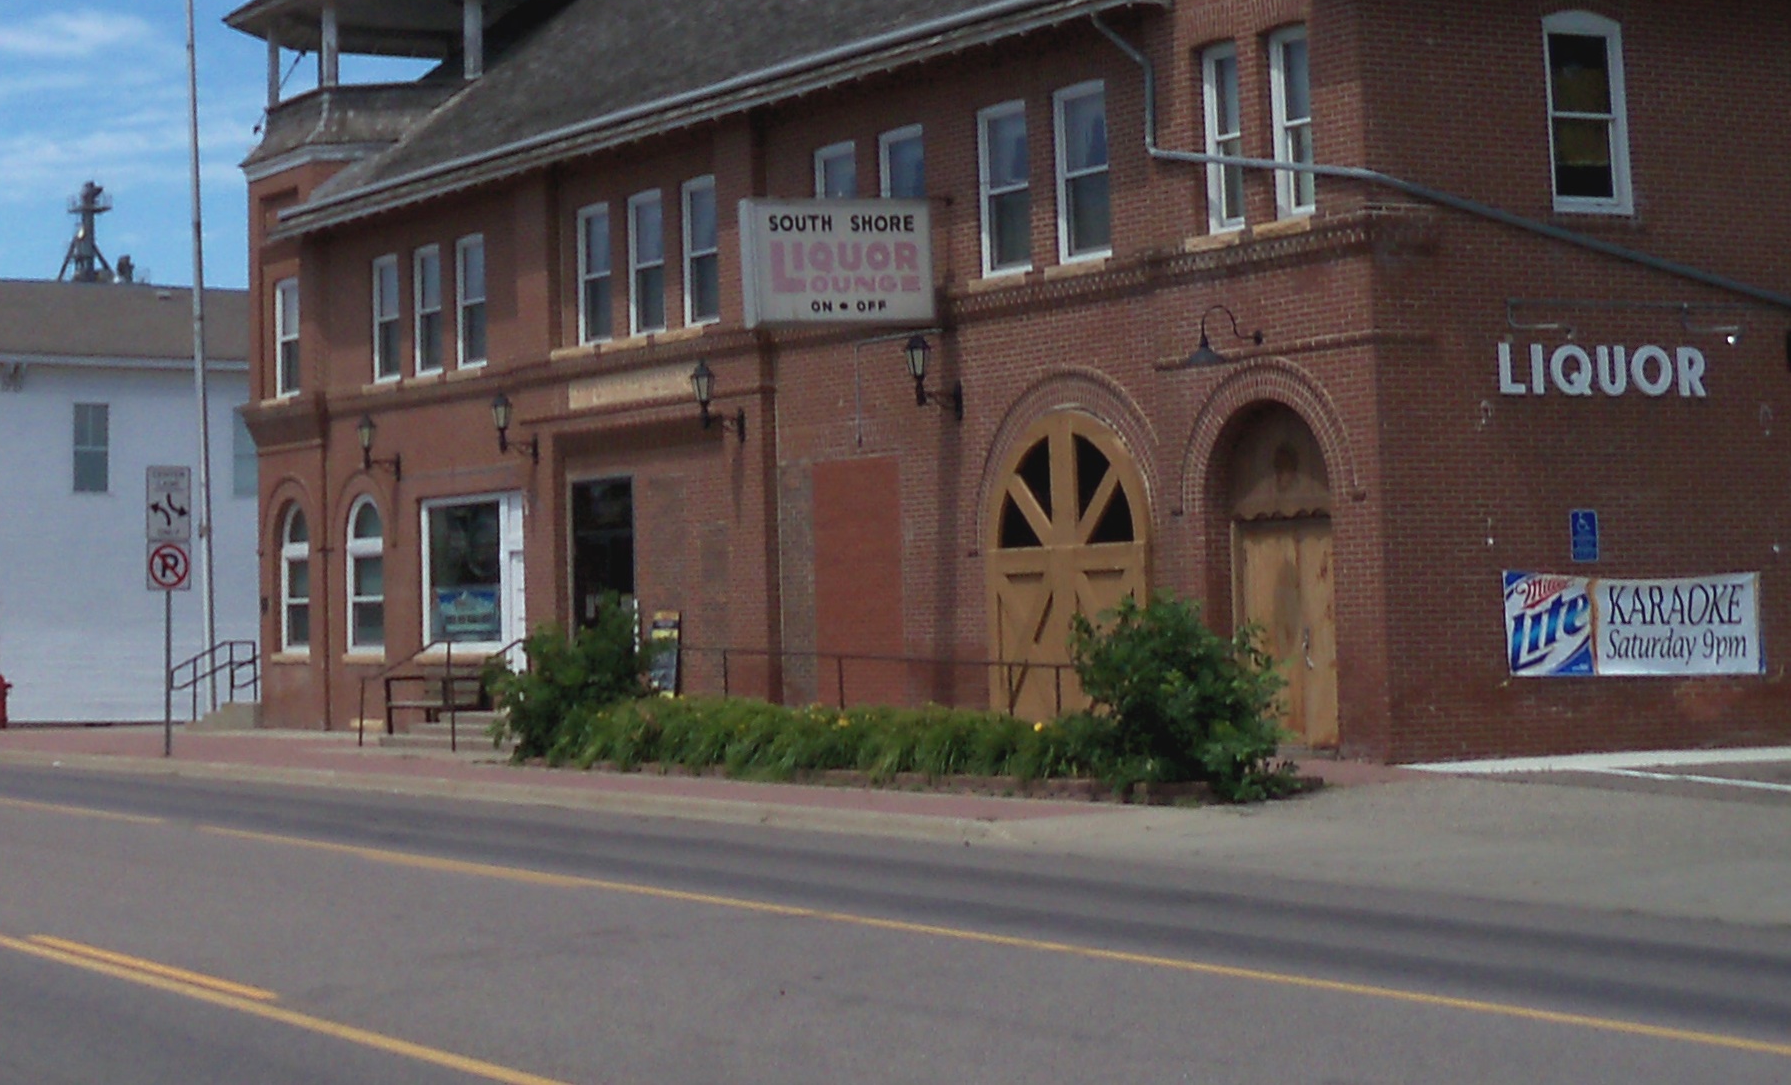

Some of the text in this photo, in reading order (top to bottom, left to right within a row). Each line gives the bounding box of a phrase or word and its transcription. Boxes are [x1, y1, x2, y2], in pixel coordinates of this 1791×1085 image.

[768, 214, 915, 233] SOUTH SHORE
[769, 240, 919, 293] LIQUOR
[811, 300, 887, 313] ON OFF
[1497, 341, 1707, 398] LIQUOR
[1607, 583, 1744, 626] KARAOKE
[1512, 593, 1590, 672] Lite
[1606, 628, 1747, 666] Saturday 9pm
